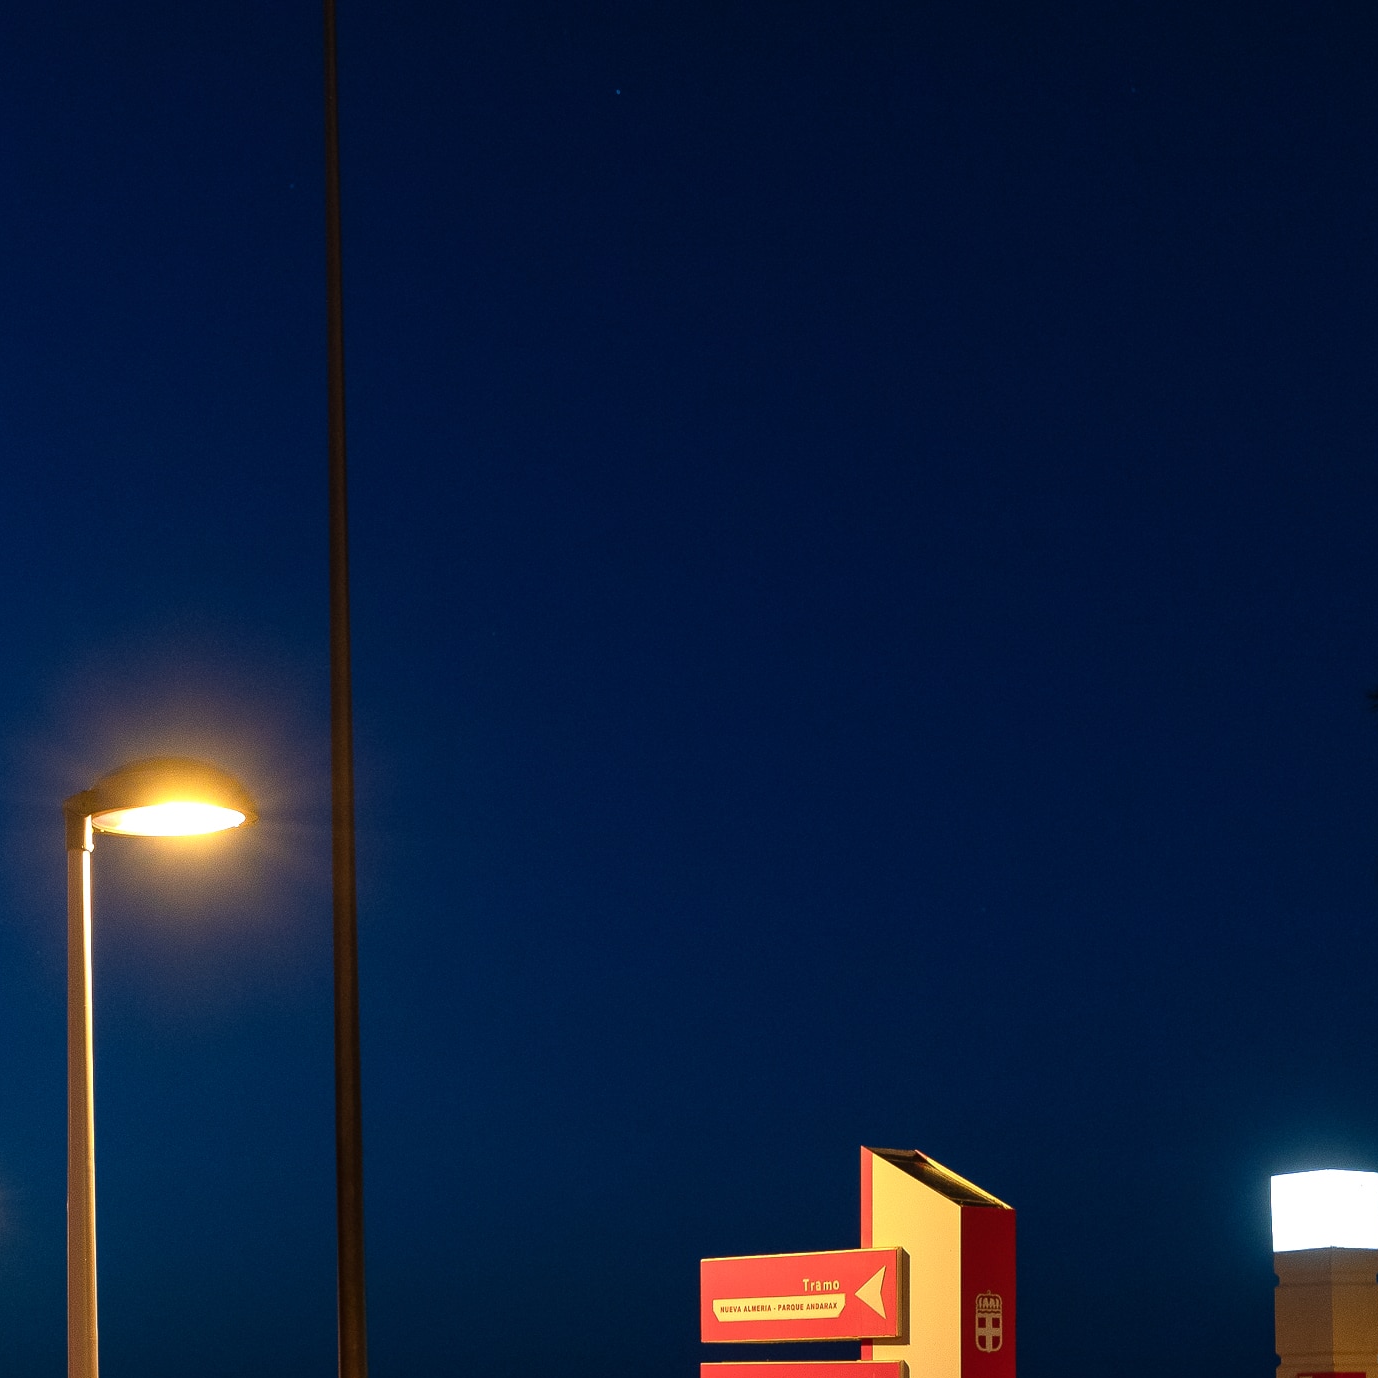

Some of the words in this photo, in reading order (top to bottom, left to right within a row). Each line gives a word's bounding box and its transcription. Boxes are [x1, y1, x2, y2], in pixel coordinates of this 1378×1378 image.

[803, 1278, 840, 1291] Tramo
[720, 1304, 742, 1313] NUEVA
[743, 1304, 772, 1312] ALMERIA
[778, 1303, 804, 1311] PARQUE
[806, 1302, 838, 1310] ANDARAX
